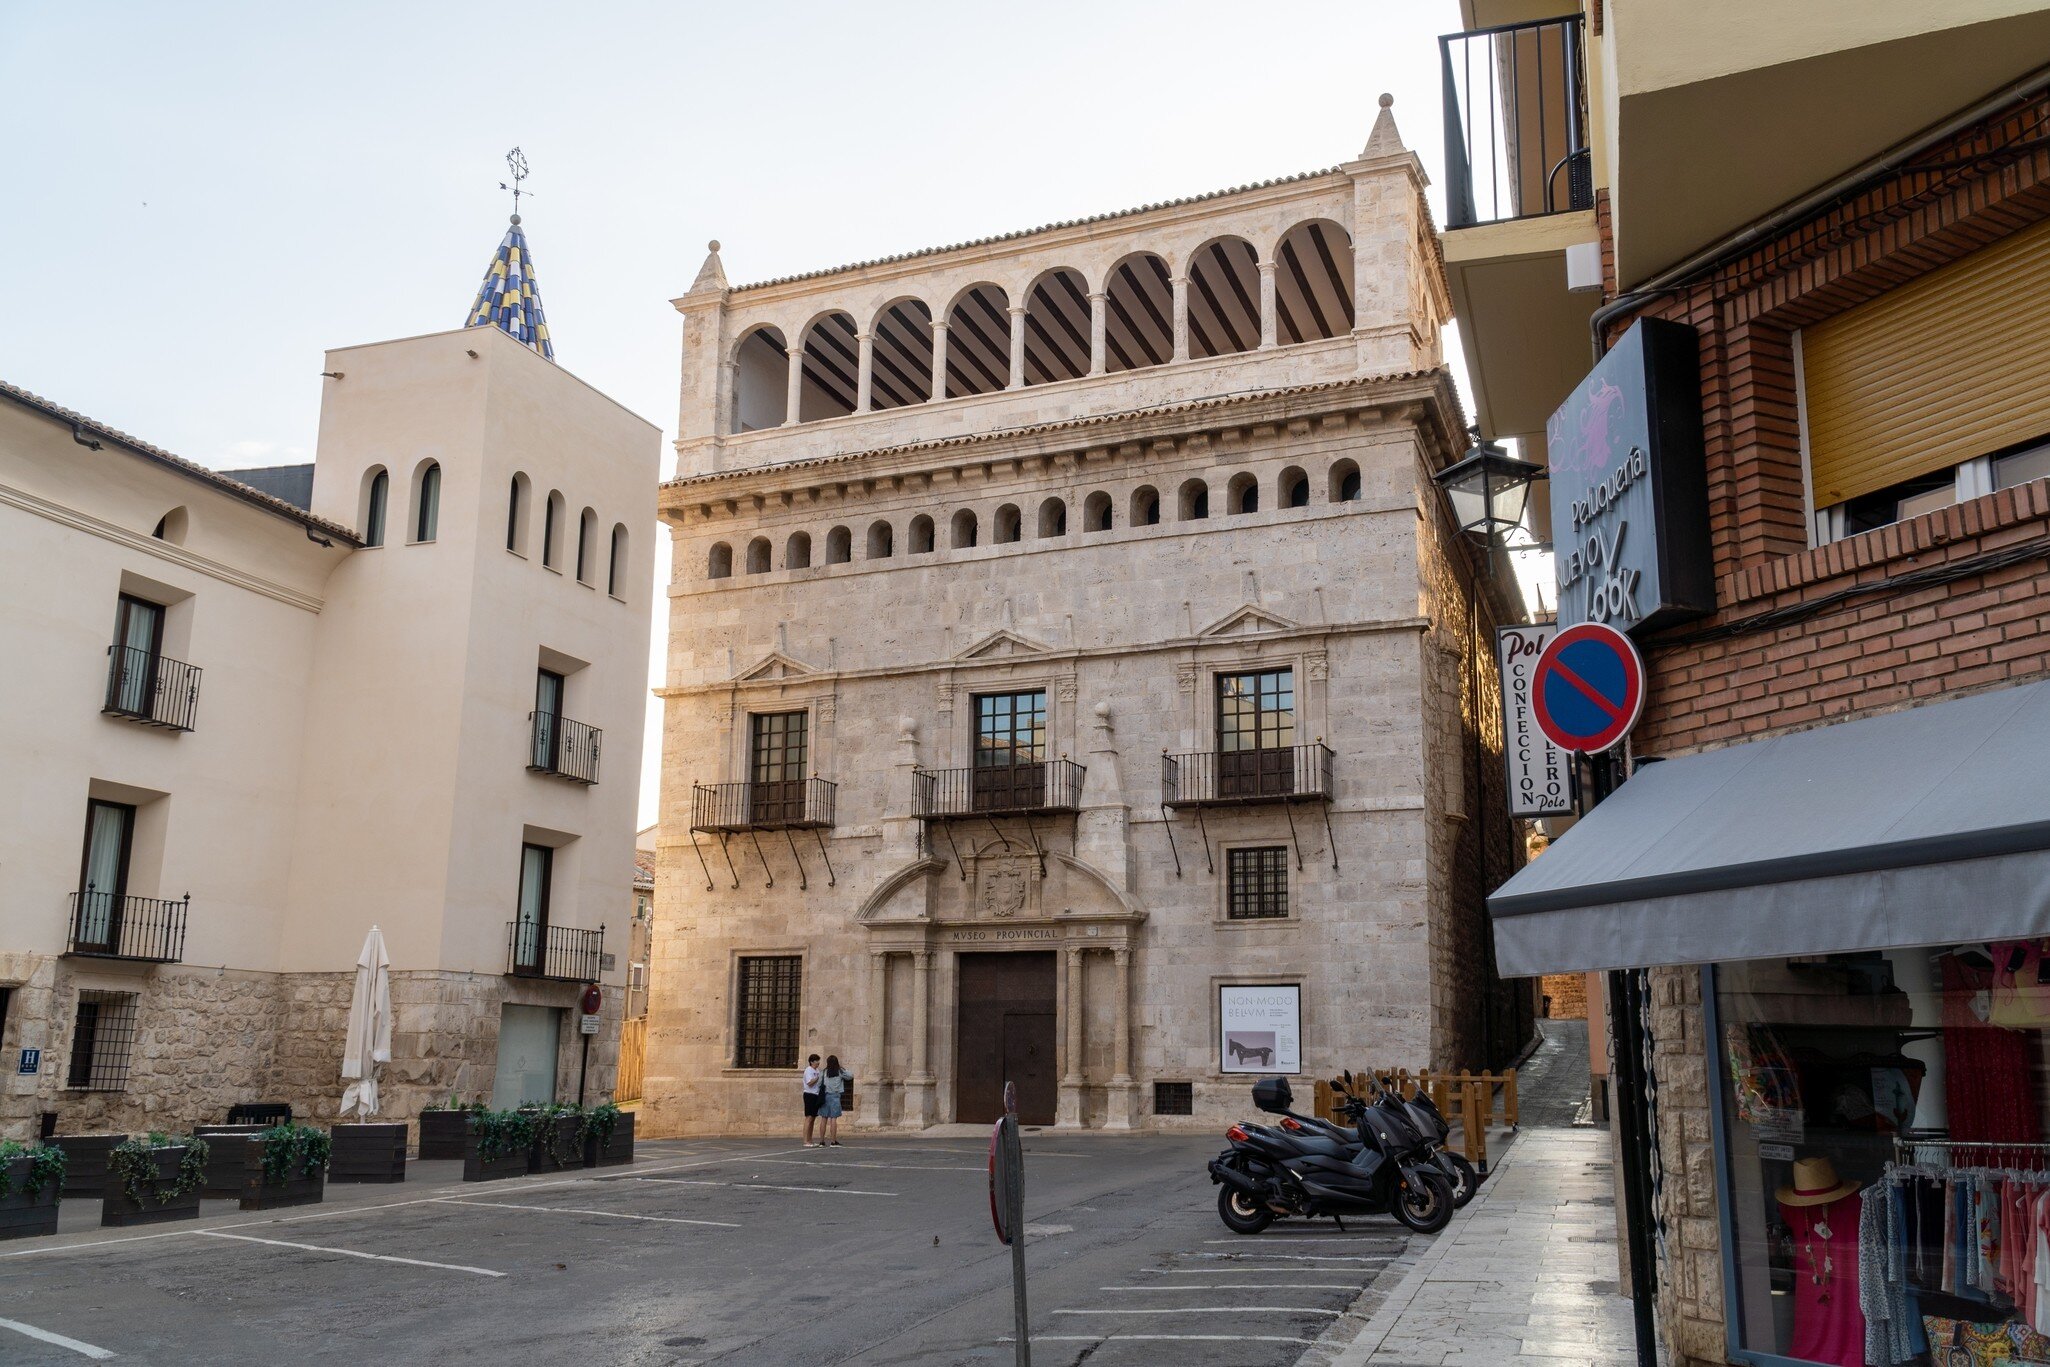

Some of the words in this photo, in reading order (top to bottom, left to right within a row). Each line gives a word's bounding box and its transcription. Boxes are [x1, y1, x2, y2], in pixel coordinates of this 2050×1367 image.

[1571, 446, 1647, 532] Peluquería
[1555, 535, 1601, 590] NUEVO
[1501, 631, 1545, 665] Pol
[1512, 664, 1534, 805] CONFECCION
[1535, 794, 1565, 812] Polo
[996, 929, 1058, 940] PROVINCIAL
[25, 1051, 36, 1064] H
